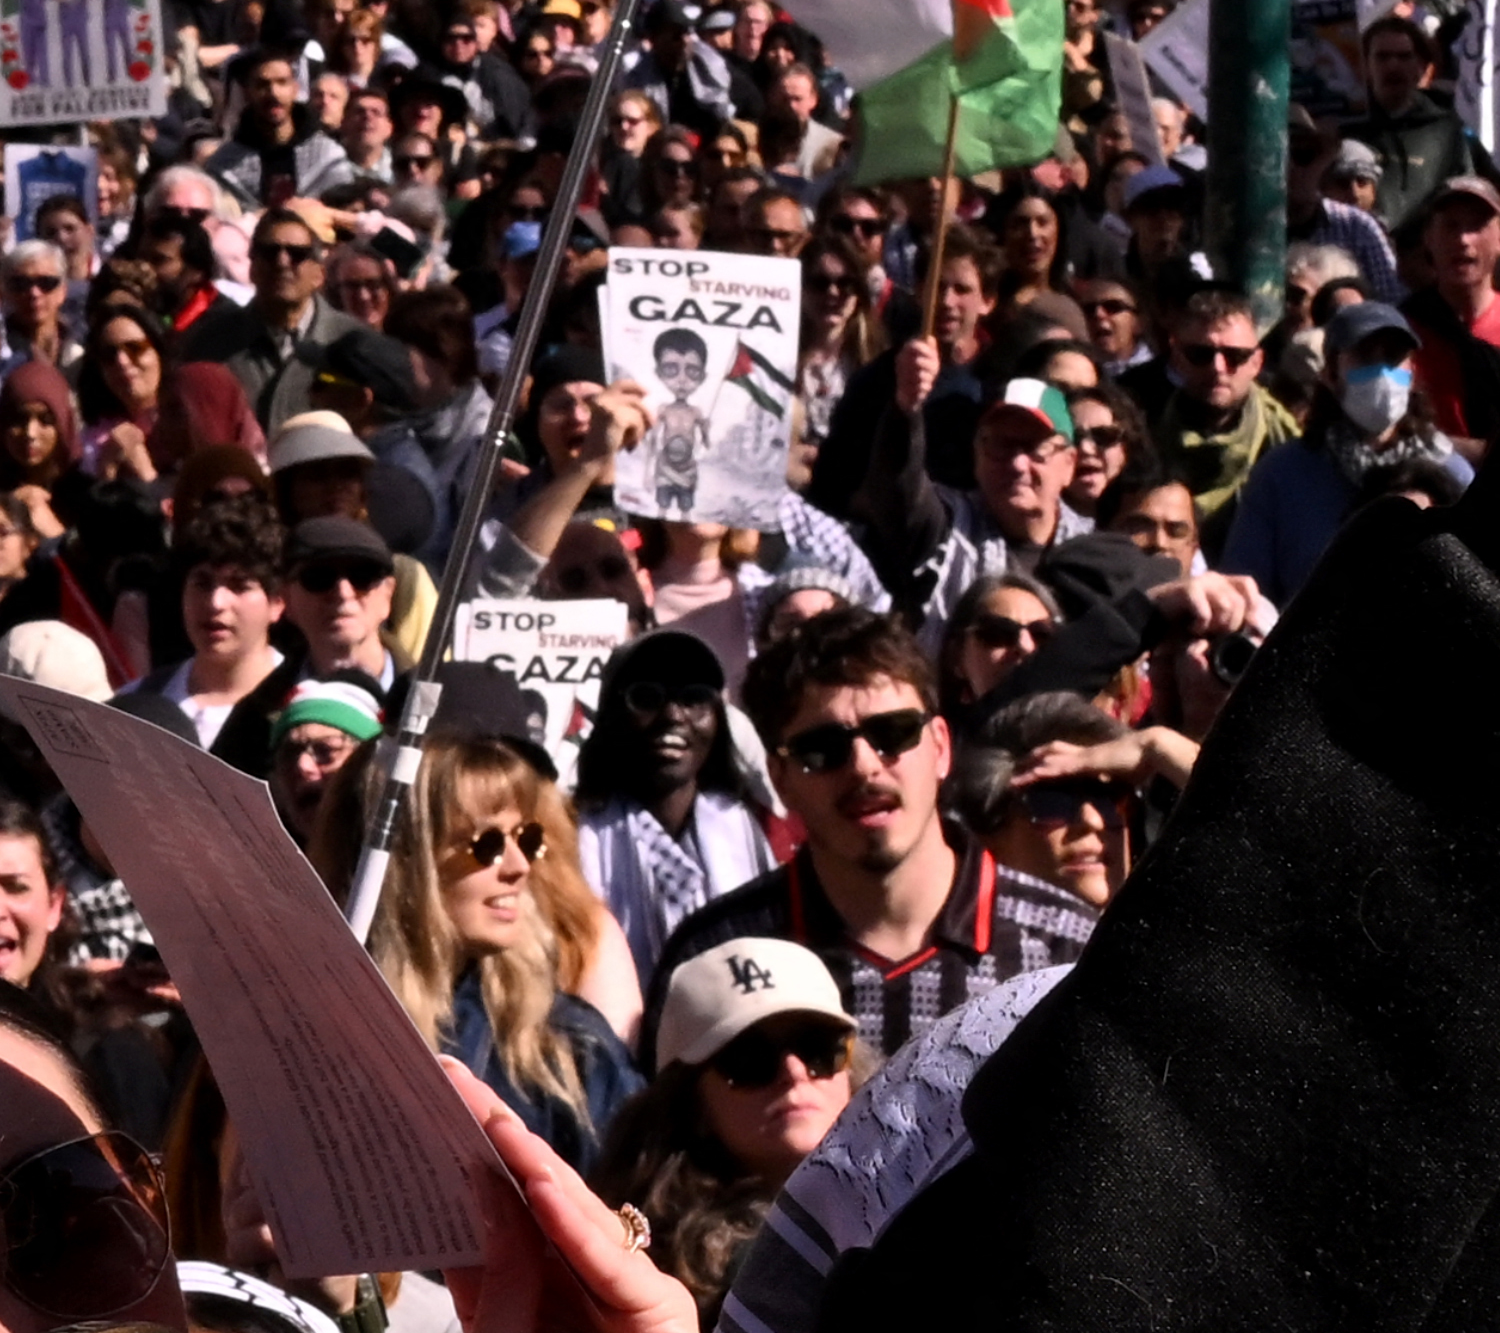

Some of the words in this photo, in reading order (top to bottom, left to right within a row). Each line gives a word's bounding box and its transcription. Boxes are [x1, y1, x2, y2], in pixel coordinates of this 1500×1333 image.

[613, 258, 709, 278] STOP
[689, 278, 791, 301] STARVING
[628, 295, 783, 334] GAZA
[474, 612, 555, 631] STOP
[538, 633, 618, 649] STARVING
[725, 954, 775, 995] LA
